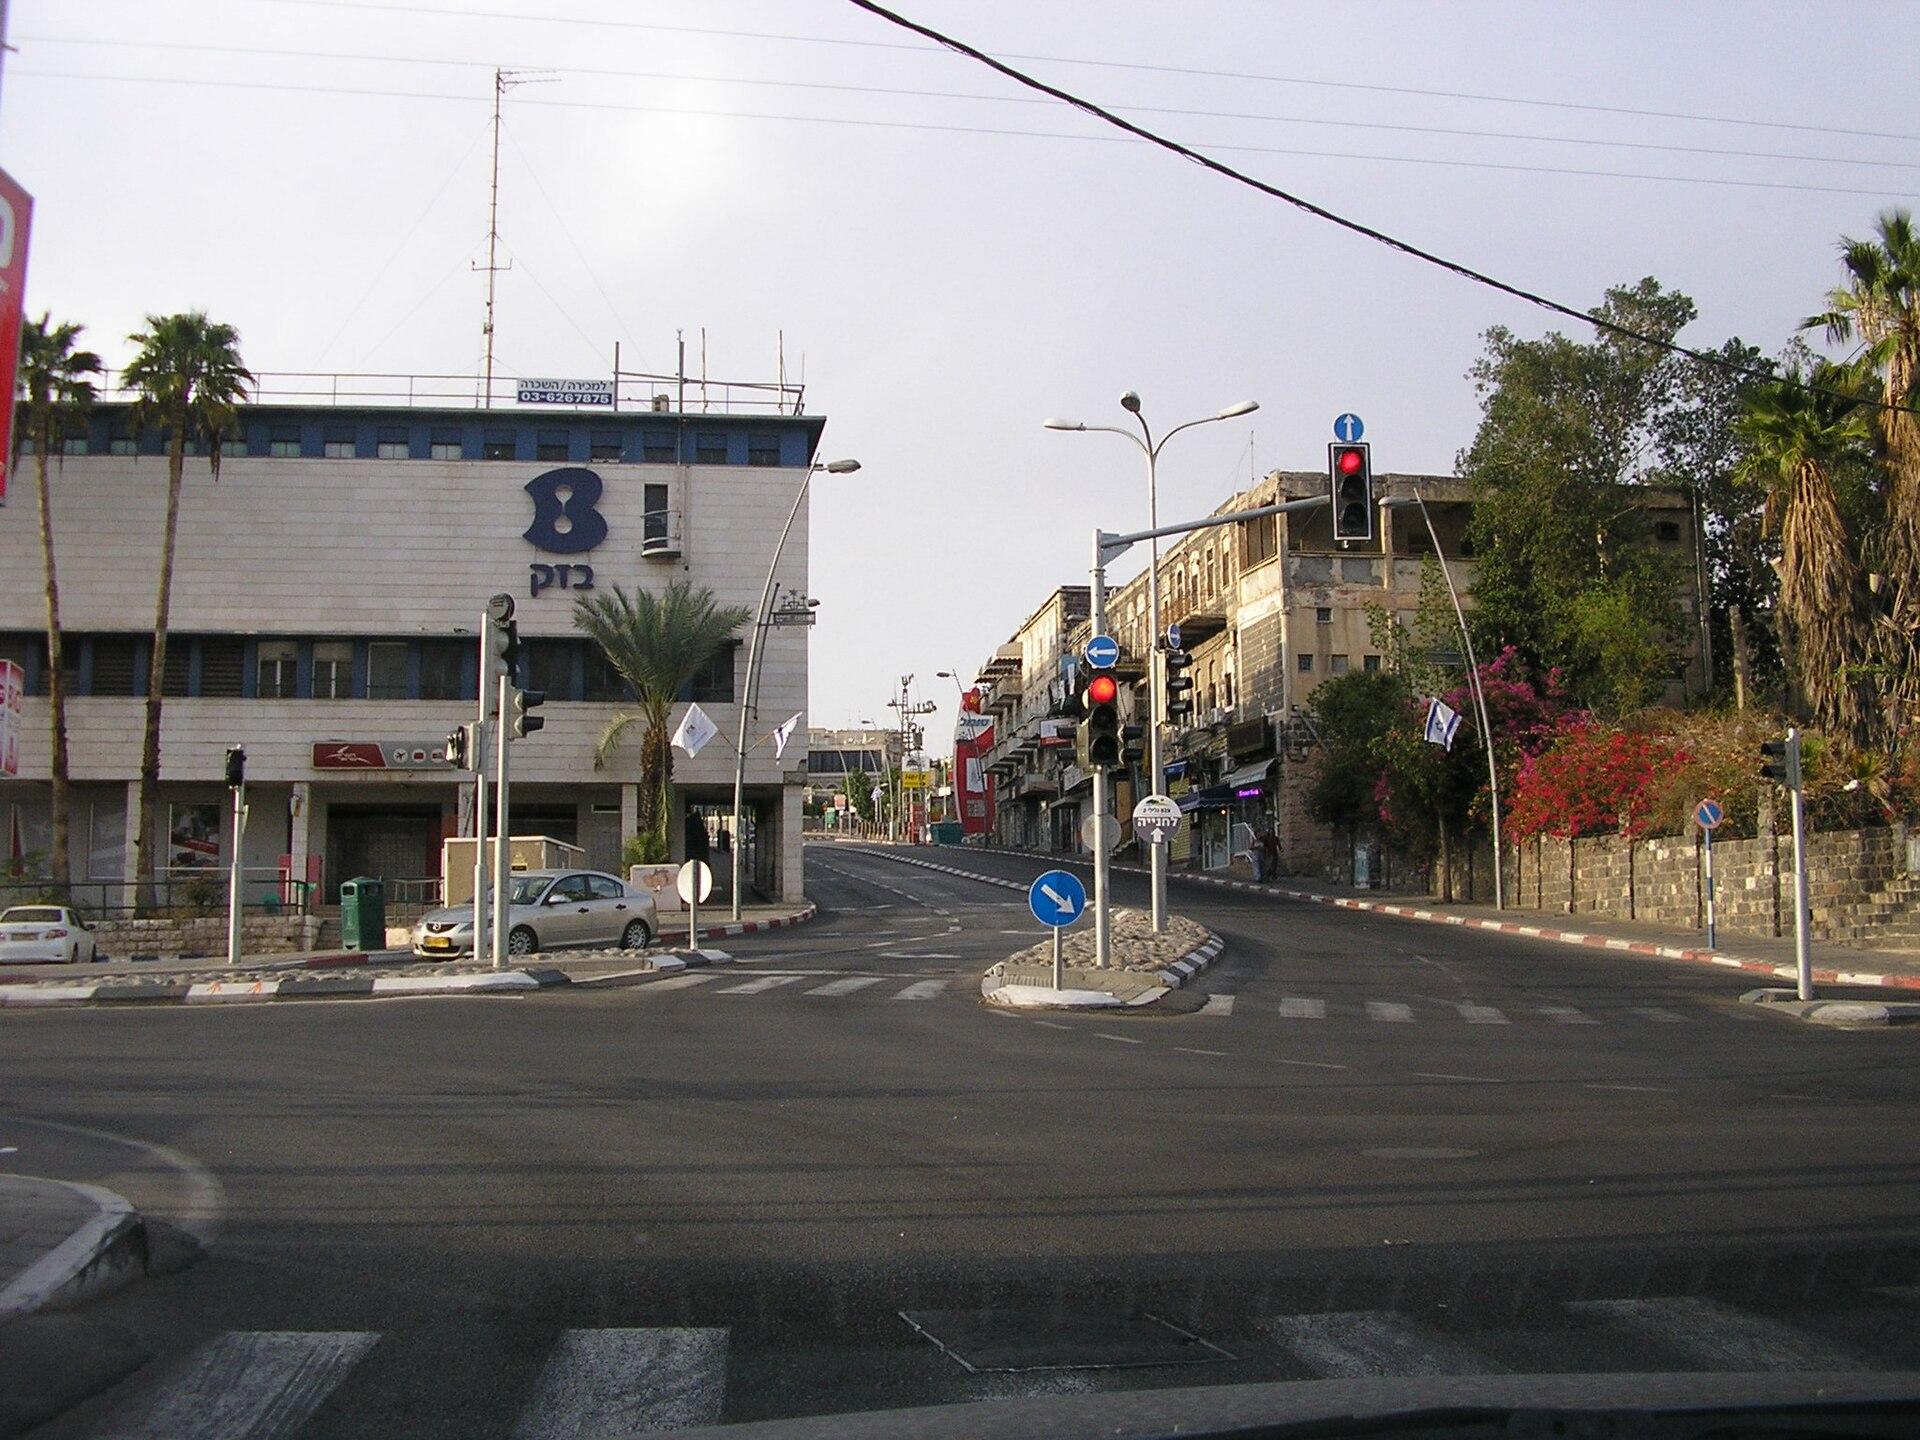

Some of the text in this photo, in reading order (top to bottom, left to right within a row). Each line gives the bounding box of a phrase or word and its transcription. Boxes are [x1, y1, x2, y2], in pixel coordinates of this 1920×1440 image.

[521, 391, 609, 403] 03-6267875
[529, 563, 594, 597] בזק
[1137, 816, 1178, 827] לחנייה
